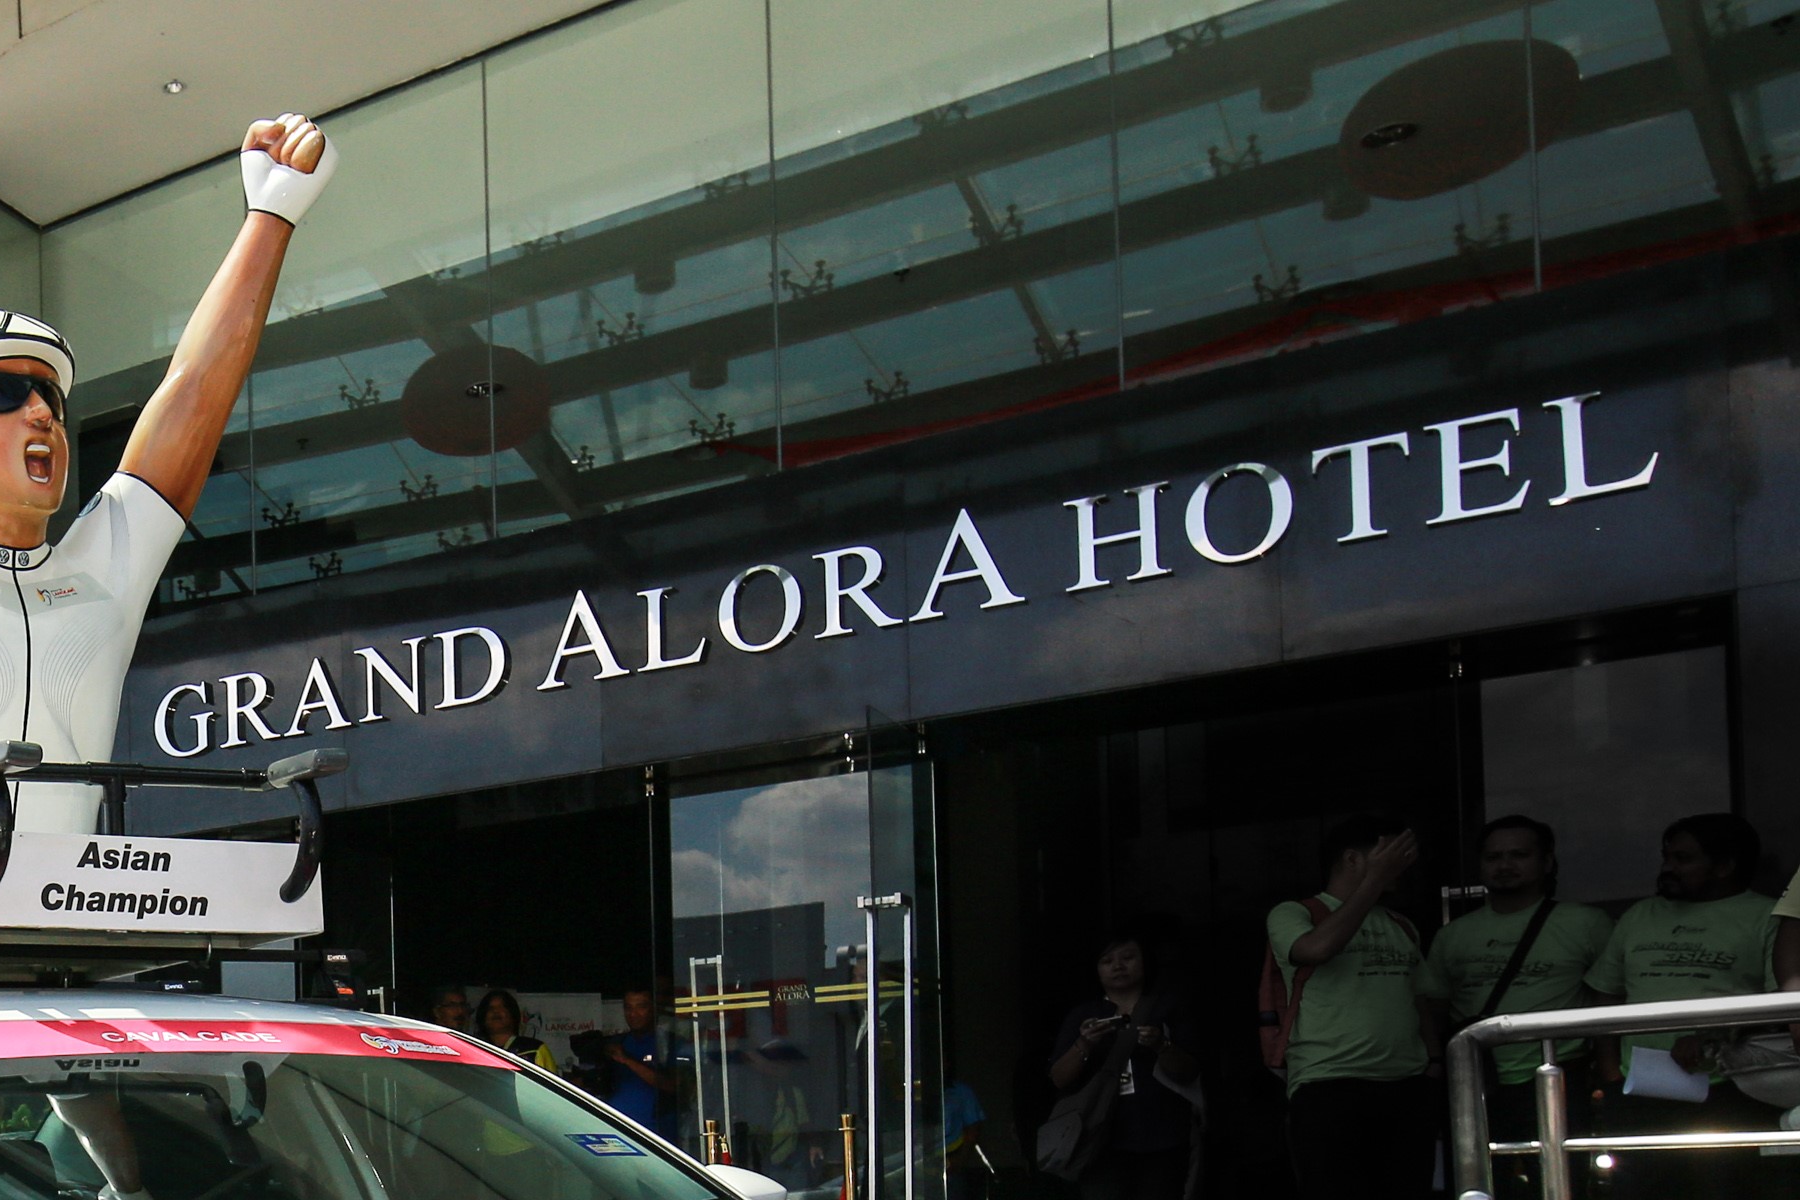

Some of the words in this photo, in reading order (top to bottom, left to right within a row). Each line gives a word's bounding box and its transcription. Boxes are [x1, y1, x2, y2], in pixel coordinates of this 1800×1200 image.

[152, 625, 510, 759] GRAND
[537, 506, 1025, 692] ALORA
[1062, 390, 1660, 594] HOTEL
[77, 841, 171, 873] Asian
[40, 883, 209, 919] Champion
[775, 990, 810, 1002] ALORA
[777, 984, 807, 993] GRAND
[101, 1031, 282, 1043] CAVALCADE
